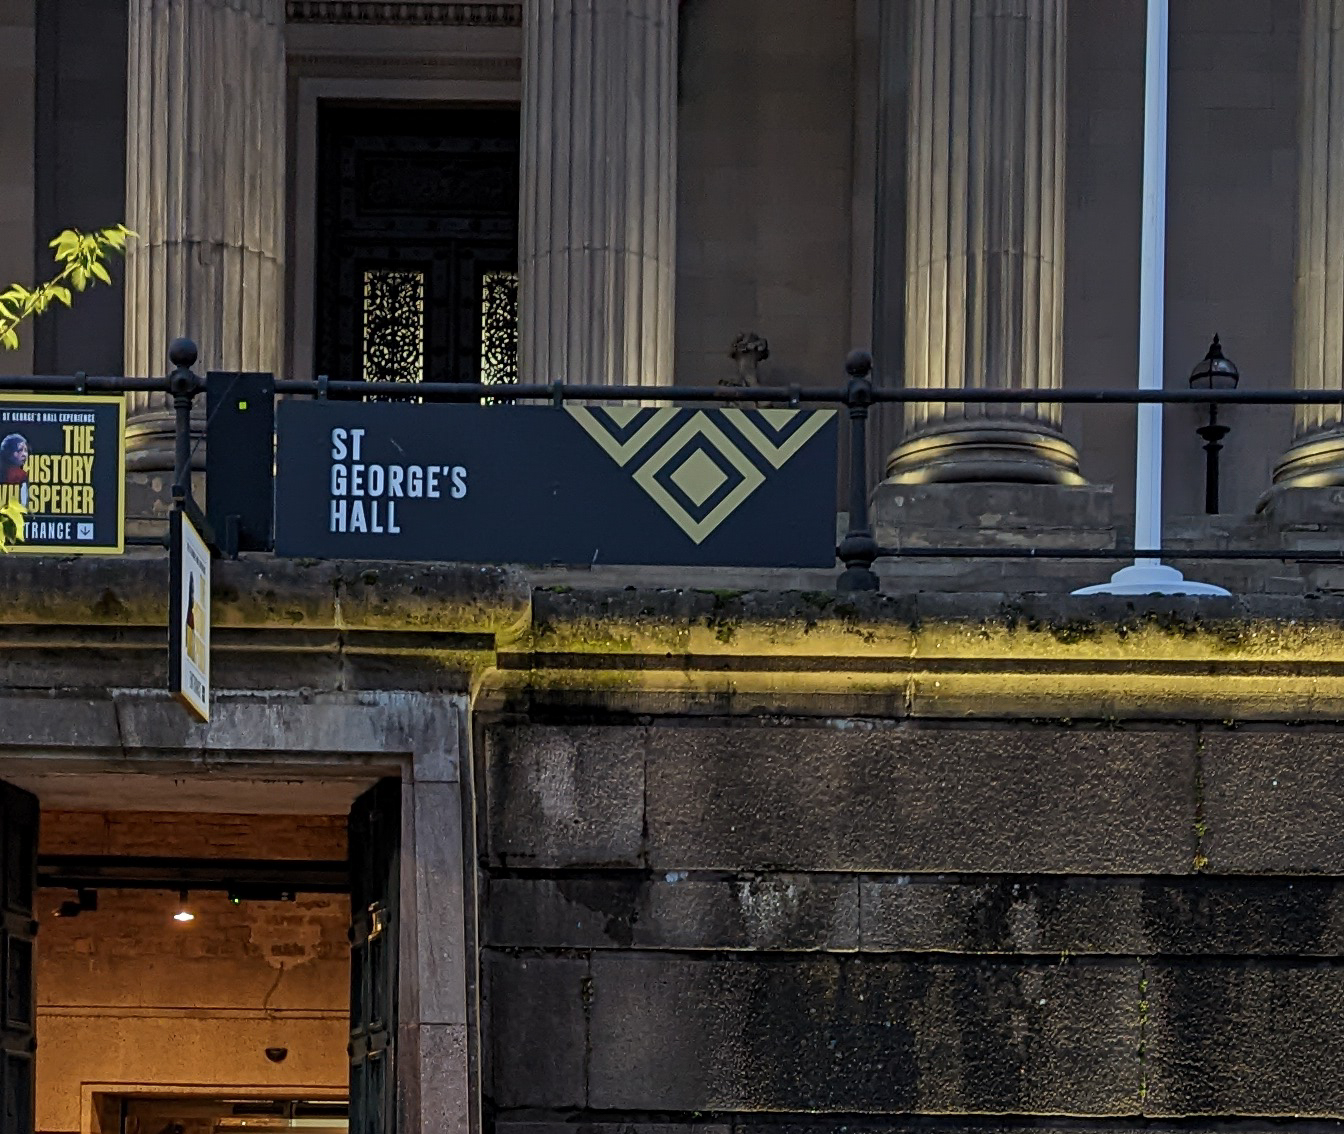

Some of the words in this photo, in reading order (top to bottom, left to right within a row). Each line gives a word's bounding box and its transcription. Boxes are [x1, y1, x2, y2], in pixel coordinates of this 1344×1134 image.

[2, 412, 10, 421] ST
[12, 412, 41, 422] GEORGE'S
[58, 413, 95, 423] EXPERIENCE
[62, 425, 95, 454] THE
[331, 428, 365, 461] ST
[23, 454, 94, 484] HISTORY
[331, 463, 467, 499] GEORGE'S
[24, 522, 72, 539] TRANCE
[330, 499, 401, 533] HALL
